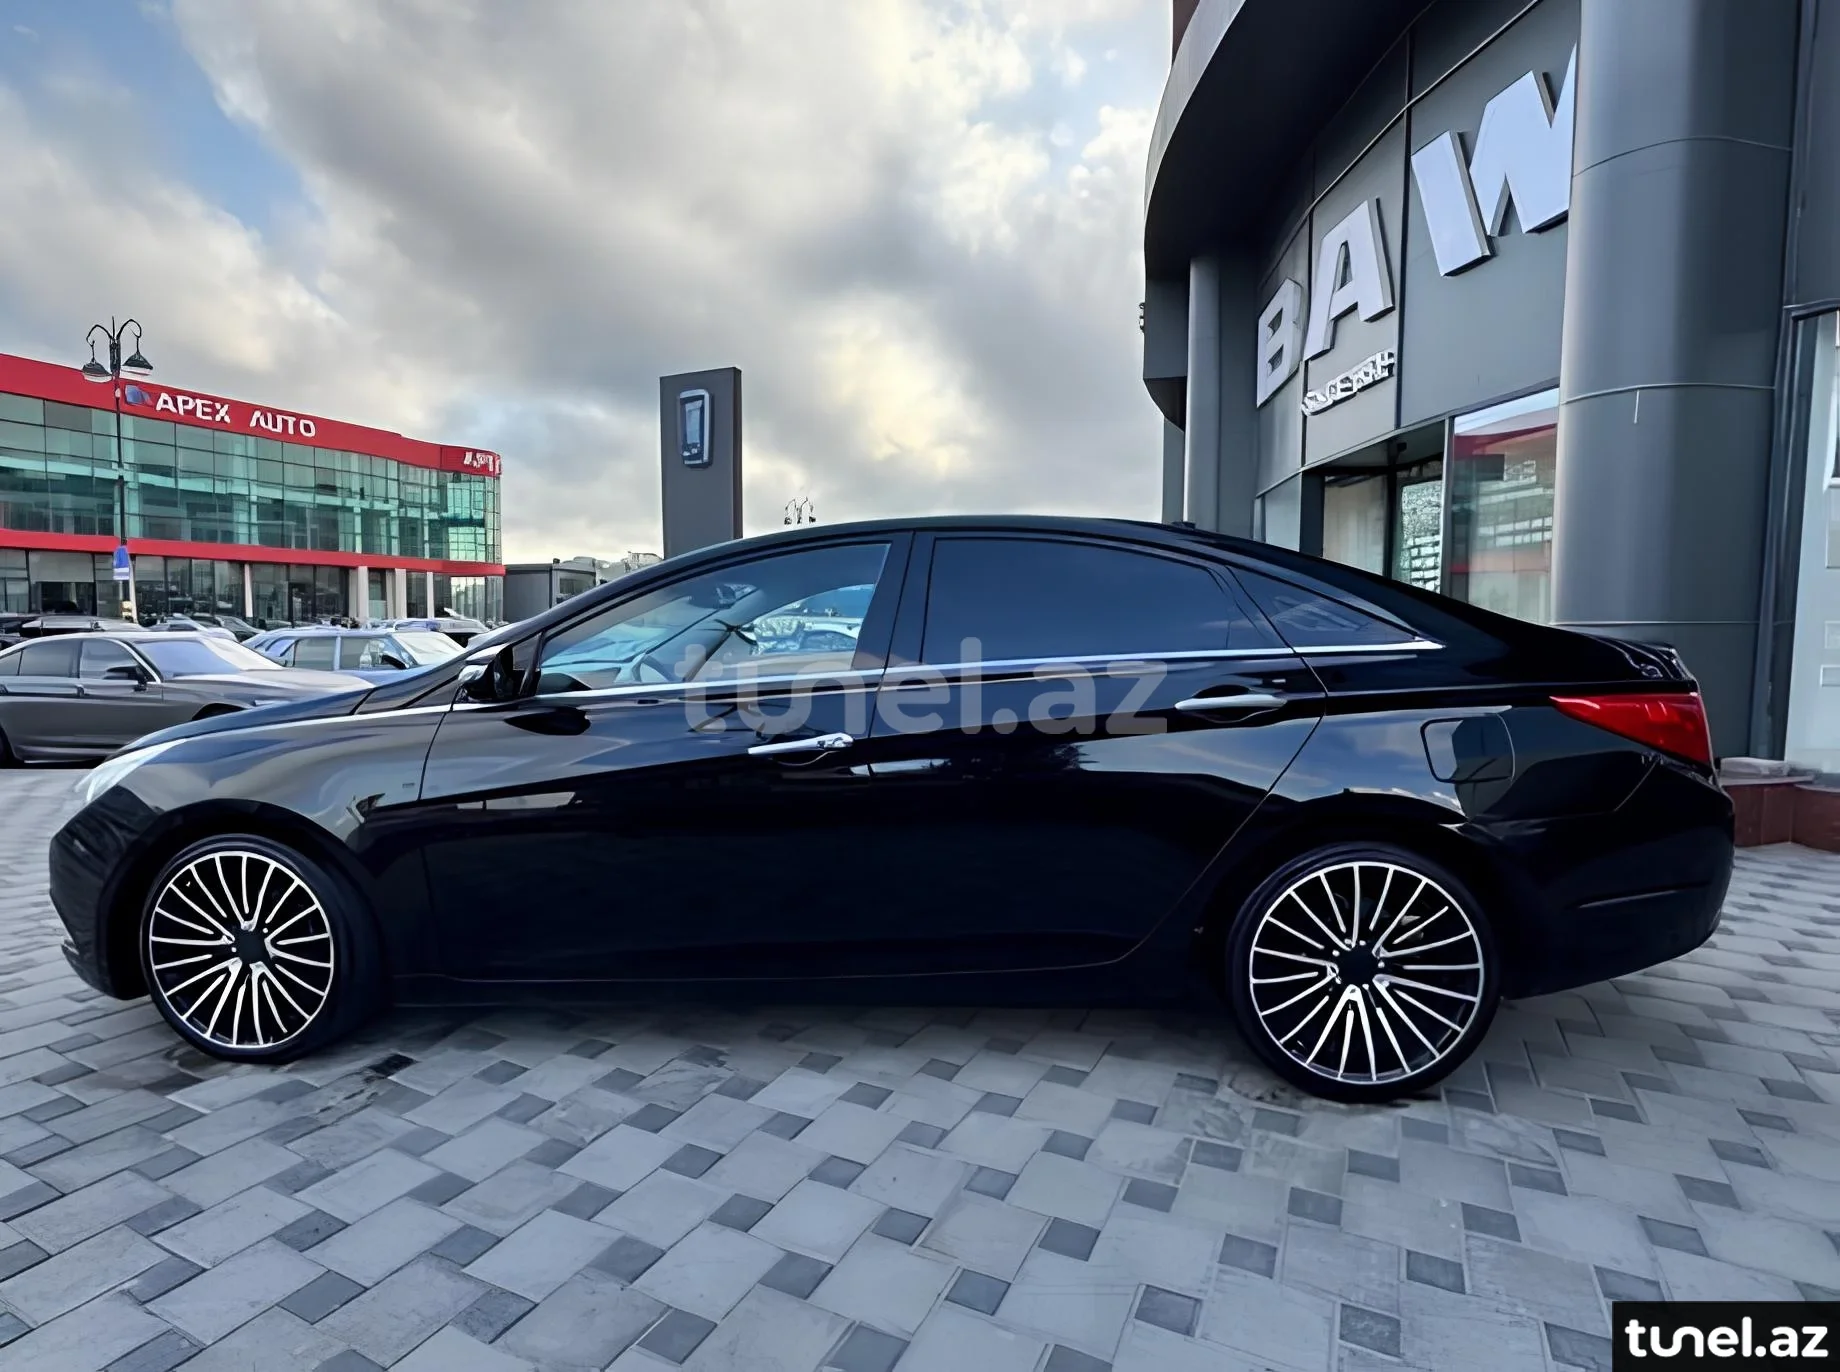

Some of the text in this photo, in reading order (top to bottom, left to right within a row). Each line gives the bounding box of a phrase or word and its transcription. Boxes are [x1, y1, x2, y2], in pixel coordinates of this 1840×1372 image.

[1256, 40, 1577, 409] BAW
[156, 392, 316, 437] APEX AUTO
